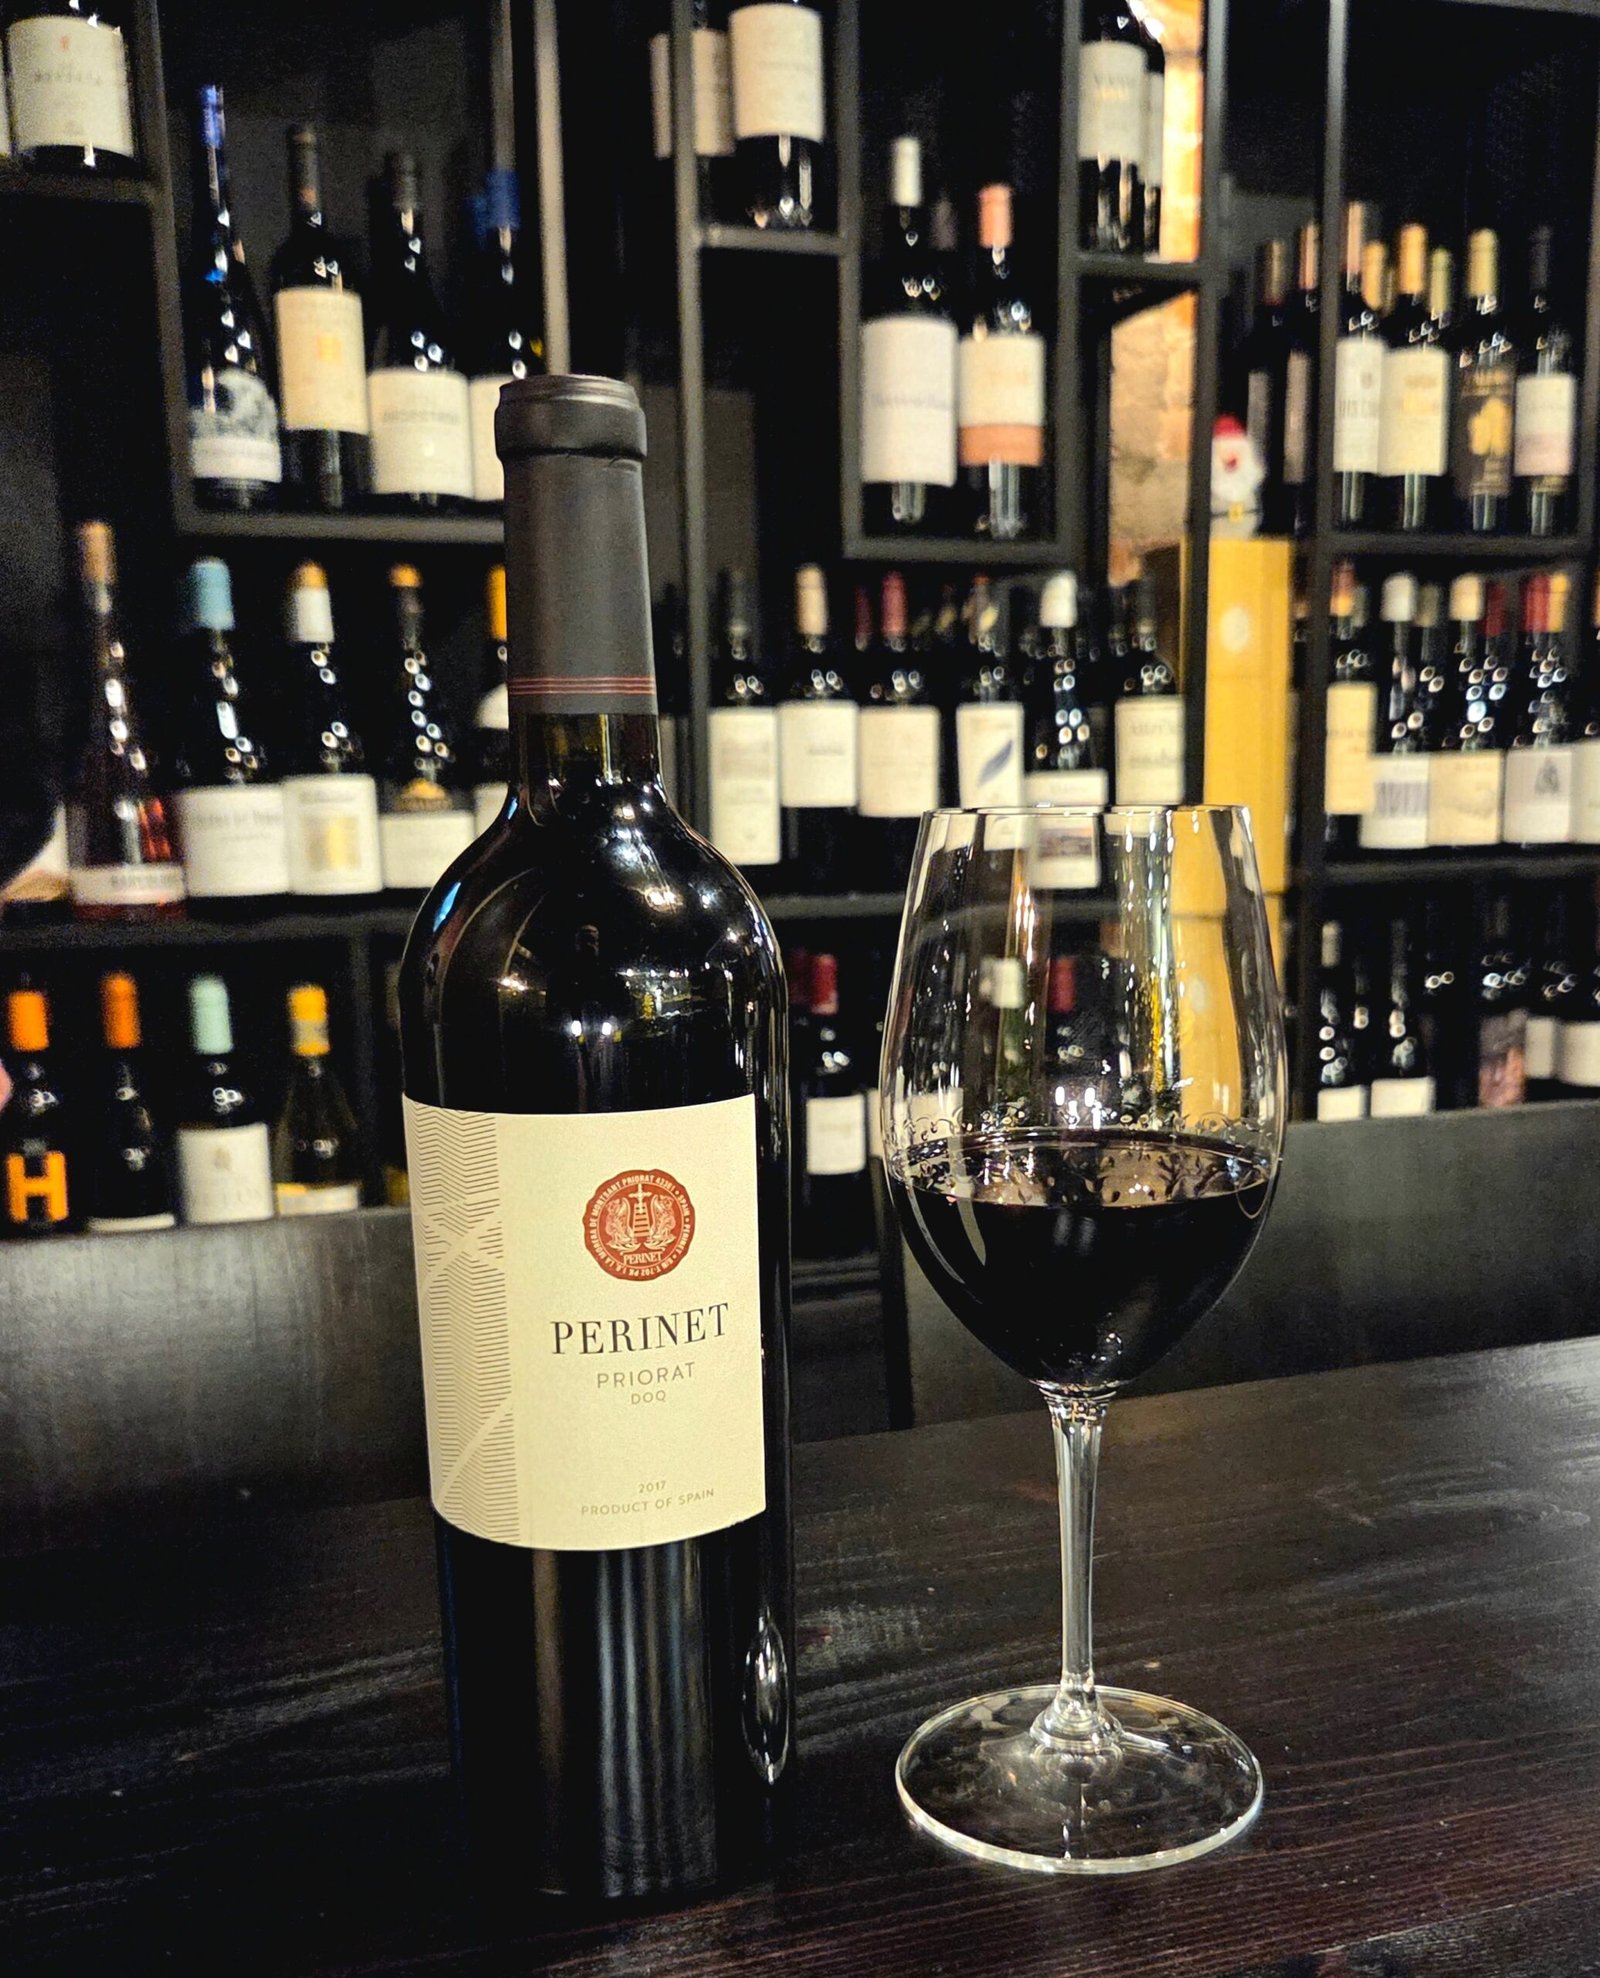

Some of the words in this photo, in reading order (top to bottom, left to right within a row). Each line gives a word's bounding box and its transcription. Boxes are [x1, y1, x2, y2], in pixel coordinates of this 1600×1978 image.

[7, 1151, 69, 1223] H
[592, 1181, 621, 1217] MONTSANT
[621, 1175, 655, 1187] PRIORAT
[679, 1194, 691, 1217] SPAIN
[623, 1251, 663, 1265] PERINET
[550, 1302, 729, 1355] PERINET
[597, 1362, 696, 1388] PRIORAT
[631, 1390, 667, 1405] DOQ
[639, 1480, 667, 1494] 2017
[581, 1501, 648, 1516] PRODUCT
[655, 1497, 672, 1509] OF
[678, 1488, 714, 1506] SPAIN
